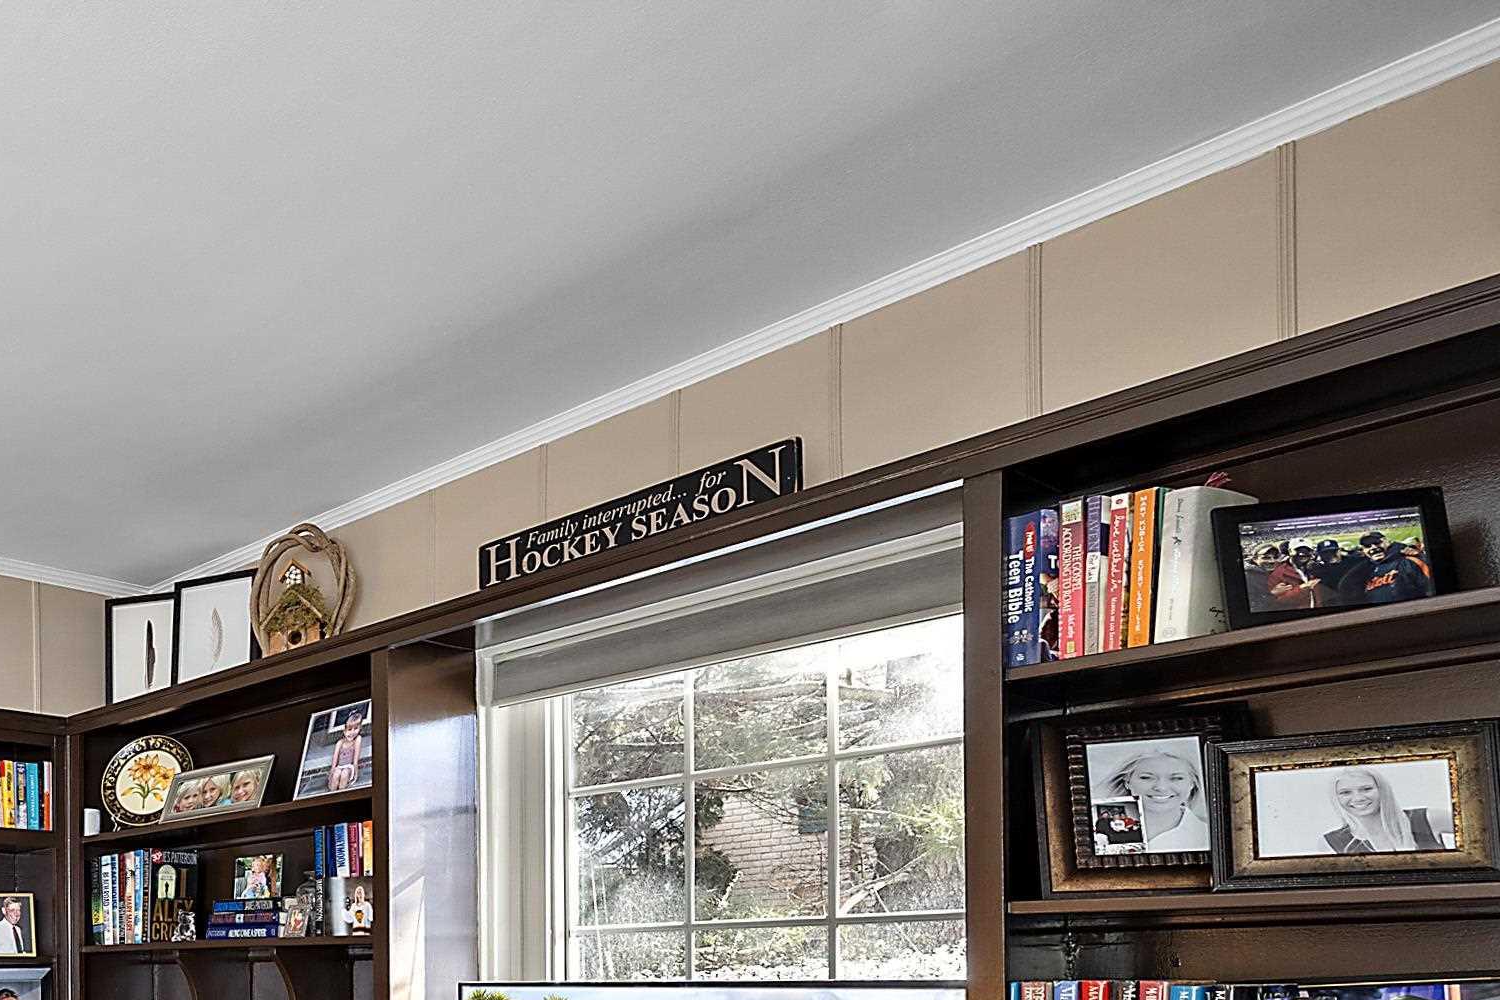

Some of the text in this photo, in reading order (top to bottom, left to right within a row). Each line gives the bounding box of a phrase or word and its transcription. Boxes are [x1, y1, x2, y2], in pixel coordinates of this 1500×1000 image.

[485, 445, 787, 587] HOCKEY SEASON
[526, 469, 727, 549] Family interrupted... for
[1007, 550, 1024, 624] Teen Bible
[1023, 557, 1035, 612] The Catholic
[1061, 527, 1072, 612] ACCORDING TO ROME
[1071, 544, 1082, 592] THE GOSPEL
